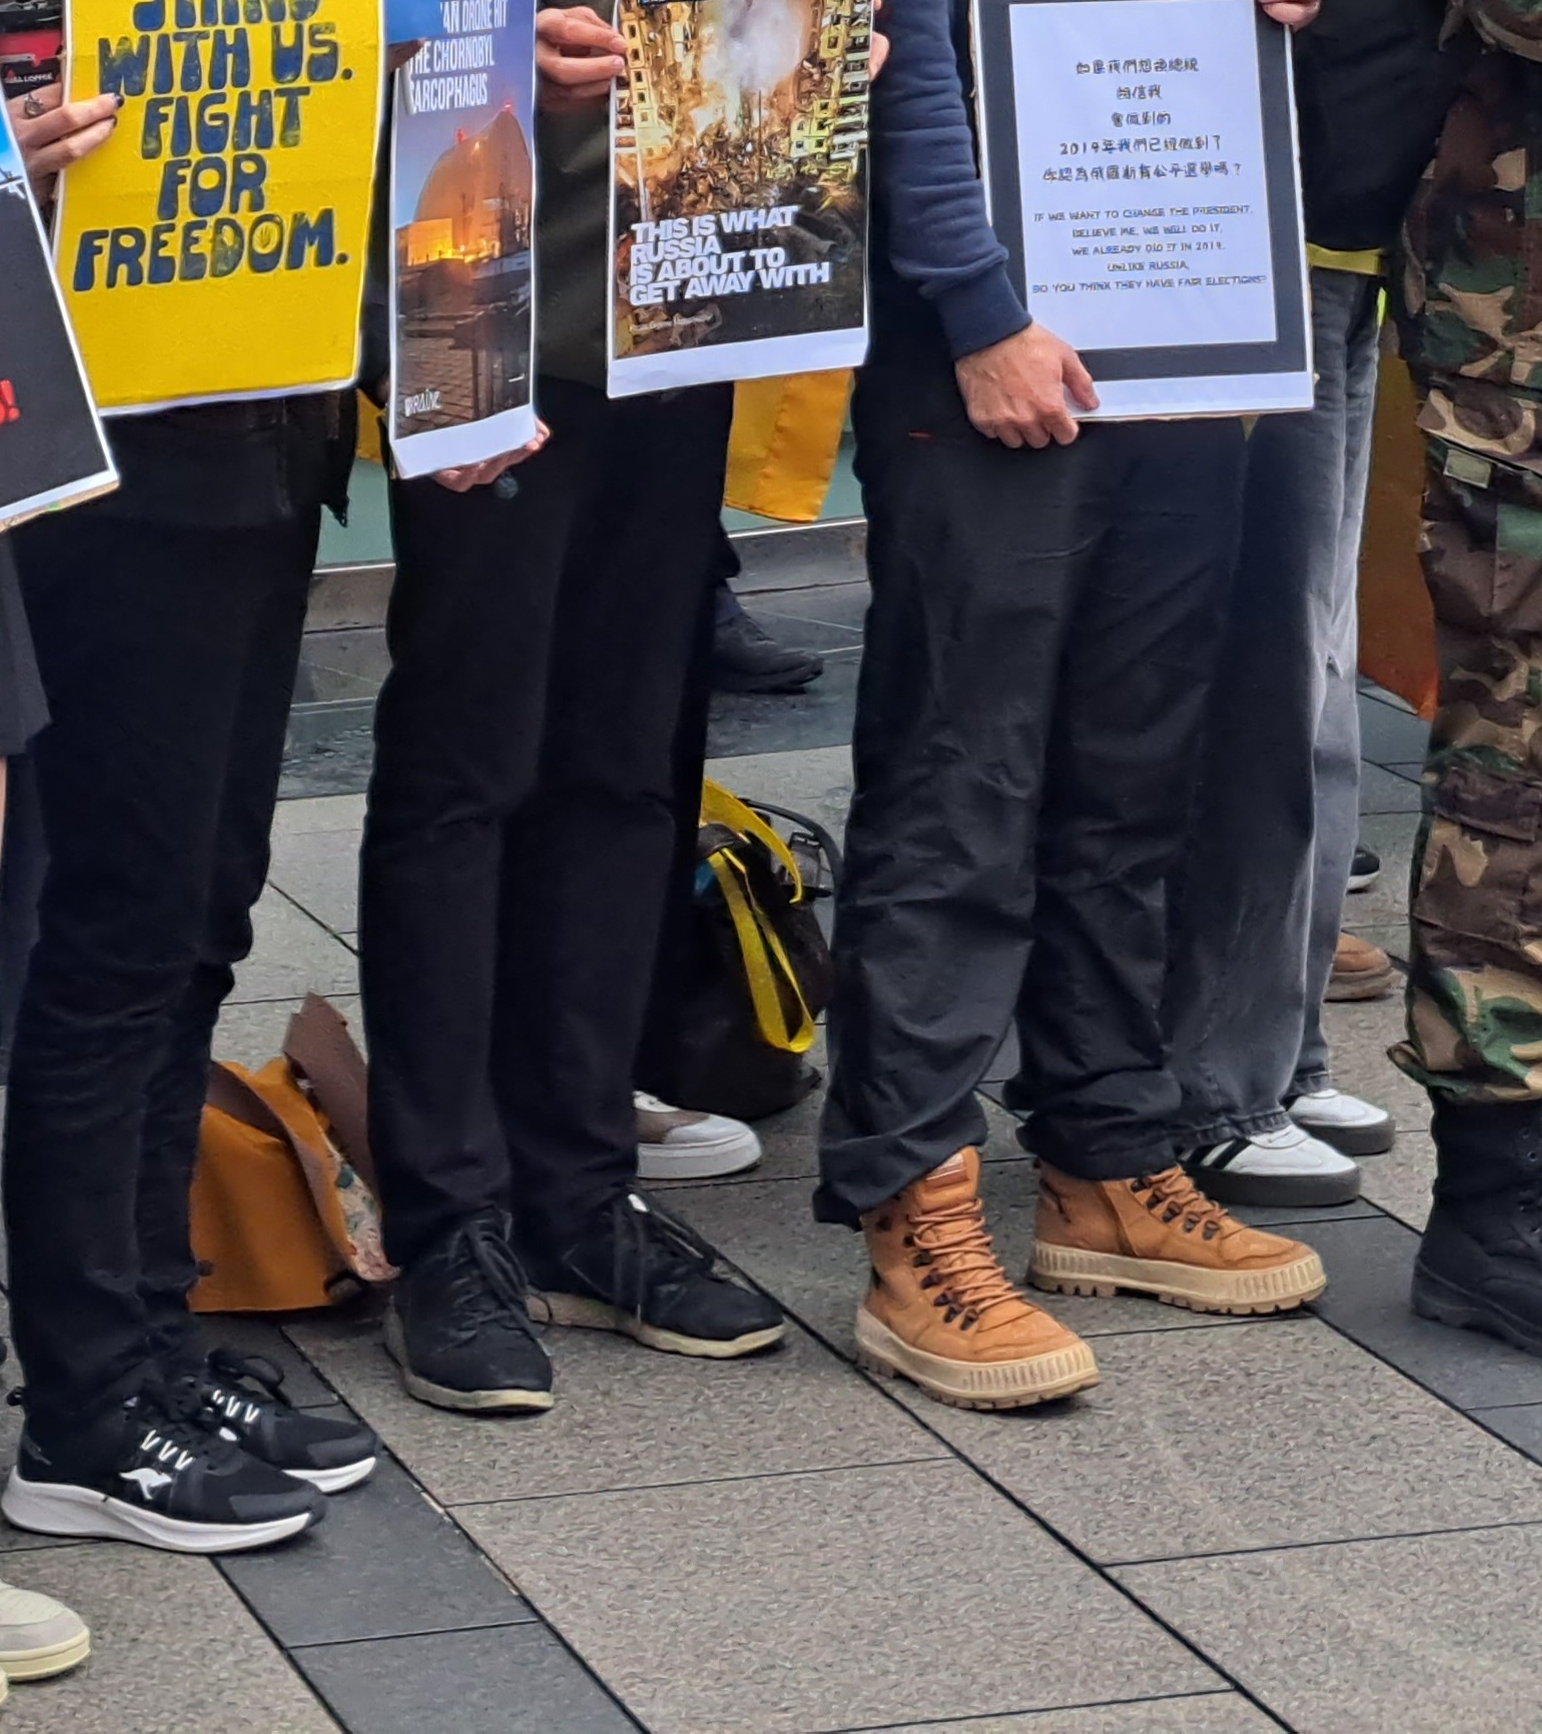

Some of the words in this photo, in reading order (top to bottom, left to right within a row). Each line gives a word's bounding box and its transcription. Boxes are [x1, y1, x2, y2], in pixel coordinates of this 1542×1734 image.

[98, 26, 251, 97] WITH
[270, 22, 353, 84] US.
[434, 34, 495, 73] CHORNOBYL
[141, 86, 311, 160] FIGHT
[157, 152, 268, 220] FOR
[631, 217, 688, 243] THIS
[693, 215, 717, 236] IS
[720, 205, 800, 233] WHAT
[1034, 212, 1045, 222] IF
[1047, 211, 1066, 221] WE
[1069, 210, 1100, 221] WANT
[1104, 209, 1120, 219] TO
[1122, 208, 1165, 218] CHANGE
[1169, 207, 1189, 216] THE
[1072, 227, 1116, 238] BELIEVE
[1142, 226, 1160, 235] WE
[1163, 224, 1186, 234] WILL
[1191, 224, 1206, 233] DO
[72, 208, 349, 292] FREEDOM.
[630, 263, 653, 285] IS
[657, 251, 746, 282] ABOUT
[749, 247, 786, 270] TO
[631, 236, 722, 265] RUSSIA
[1072, 246, 1089, 256] WE
[1092, 244, 1142, 255] ALREADY
[1145, 243, 1163, 252] DID
[1166, 242, 1179, 252] IT
[1181, 242, 1192, 251] IN
[1107, 262, 1145, 272] UNLIKE
[630, 280, 680, 306] GET
[684, 270, 757, 299] AWAY
[758, 262, 830, 290] WITH
[1032, 284, 1048, 294] DO
[1052, 283, 1076, 293] YOU
[1079, 282, 1111, 292] THINK
[1115, 280, 1142, 290] THEY
[1145, 279, 1174, 288] HAVE
[1178, 277, 1202, 287] FAIR
